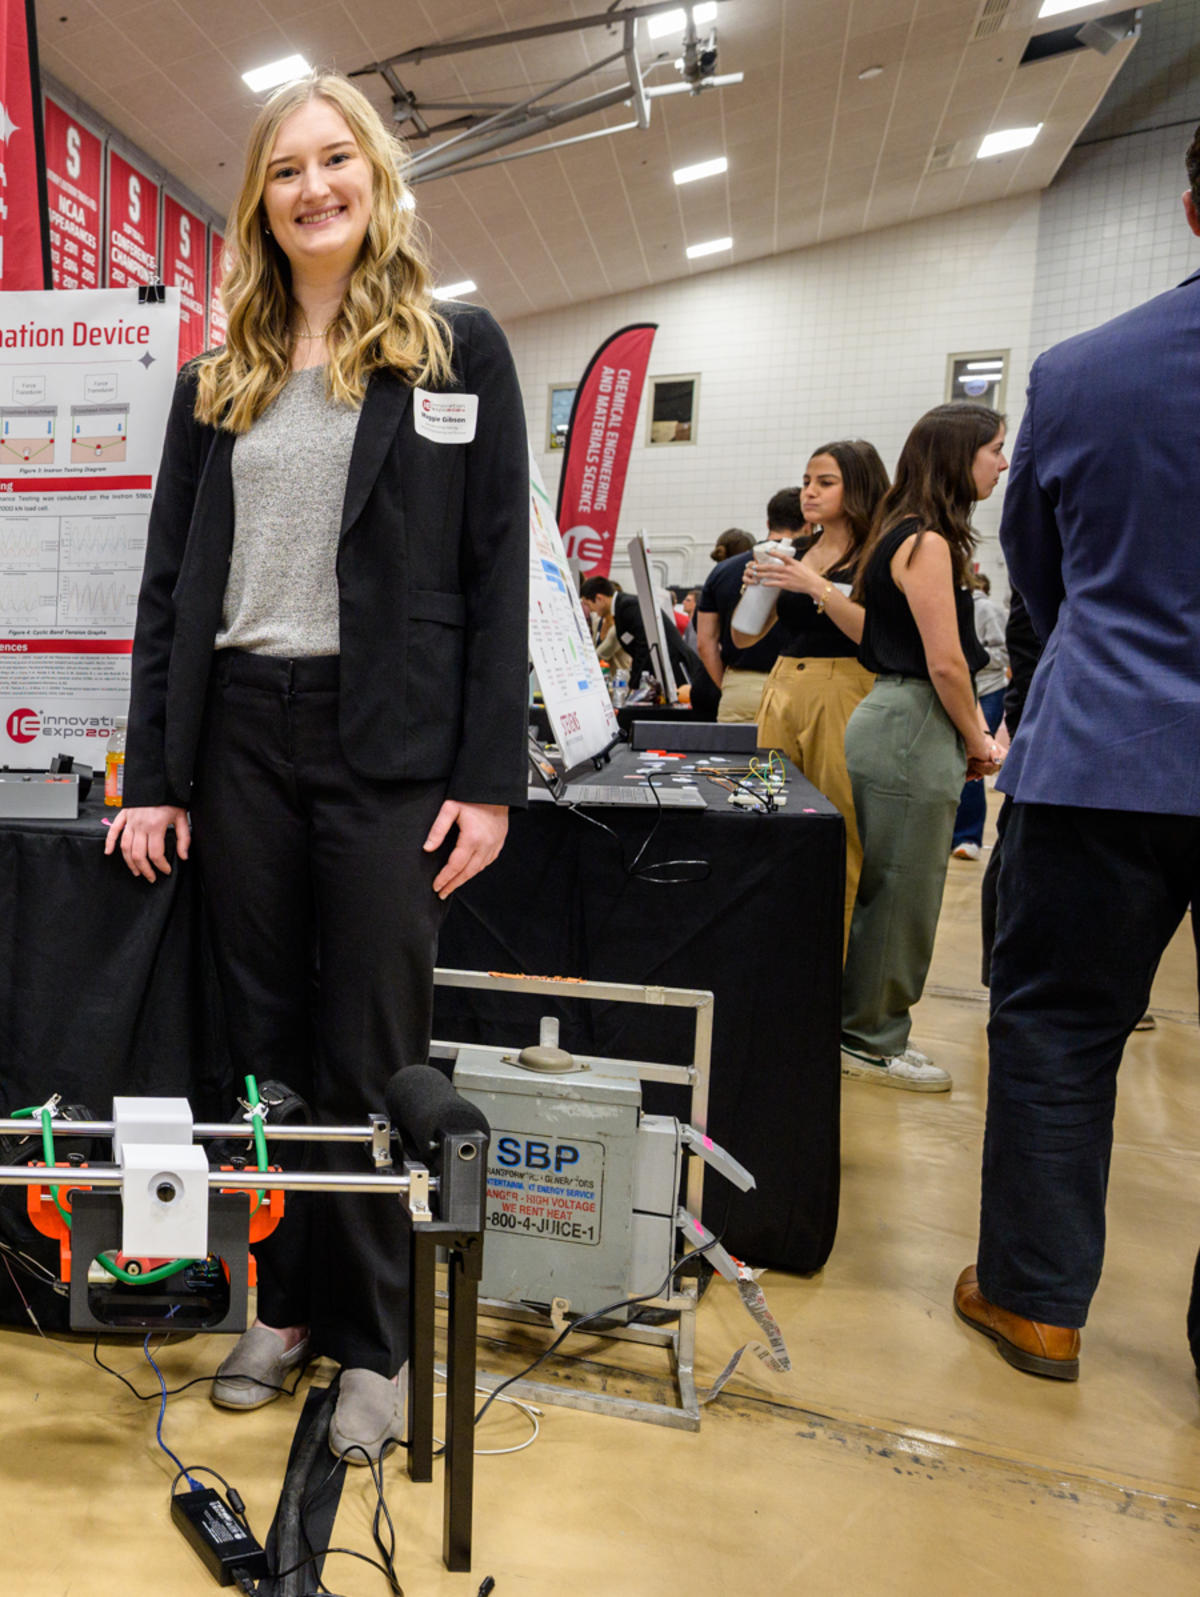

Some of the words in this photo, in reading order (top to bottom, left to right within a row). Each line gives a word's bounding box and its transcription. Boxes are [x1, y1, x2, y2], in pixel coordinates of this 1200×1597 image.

[65, 125, 81, 180] S
[58, 194, 86, 227] NCAA
[128, 174, 141, 224] S
[180, 214, 191, 259] S
[73, 319, 150, 346] Device
[598, 365, 615, 392] AND
[607, 368, 631, 428] CHEMICAL
[585, 395, 611, 464] MATERIALS
[593, 431, 619, 512] ENGINEERING
[578, 466, 598, 514] SCIENCE
[42, 715, 114, 726] innovati
[496, 1137, 580, 1173] SBP
[486, 1189, 519, 1201] ANGER
[526, 1194, 550, 1206] HIGH
[551, 1197, 596, 1214] VOLTAGE
[502, 1201, 517, 1213] WE
[519, 1204, 545, 1217] RENT
[546, 1208, 573, 1221] HEAT
[566, 1188, 595, 1200] SERVICE
[486, 1211, 595, 1241] -800-4-JUICE-1
